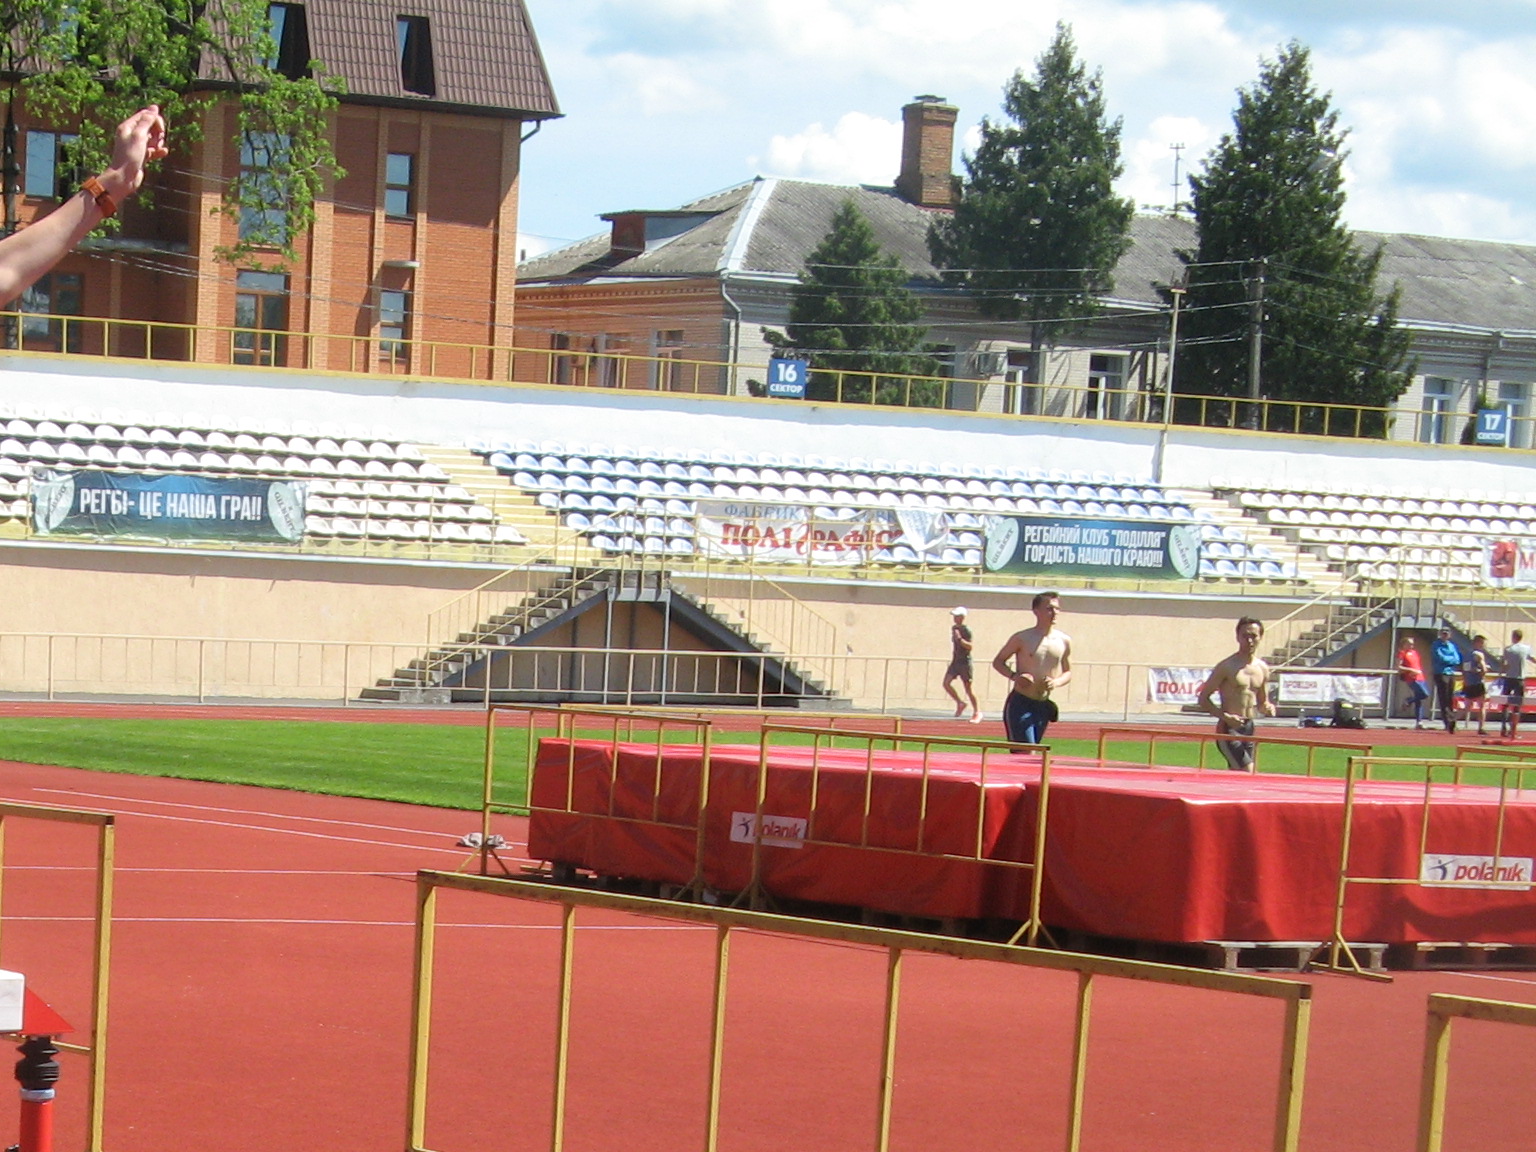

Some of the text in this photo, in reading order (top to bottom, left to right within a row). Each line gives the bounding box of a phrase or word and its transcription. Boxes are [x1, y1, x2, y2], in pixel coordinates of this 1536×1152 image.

[777, 362, 798, 383] 16
[770, 383, 804, 394] СЕКТОР
[1484, 413, 1503, 431] 17
[139, 491, 162, 520] ЦЕ
[166, 492, 216, 519] НАША
[220, 494, 262, 521] ГРА!!
[724, 504, 800, 520] ФАБРИК
[1024, 523, 1167, 549] РЕГБІЙНИЙ КЛУБ "ПОДІЛЛЯ"
[1024, 544, 1076, 565] ГОРДІСТЬ
[1077, 546, 1121, 566] НАШОГО
[752, 820, 800, 838] olanik
[1453, 861, 1525, 882] polanik
